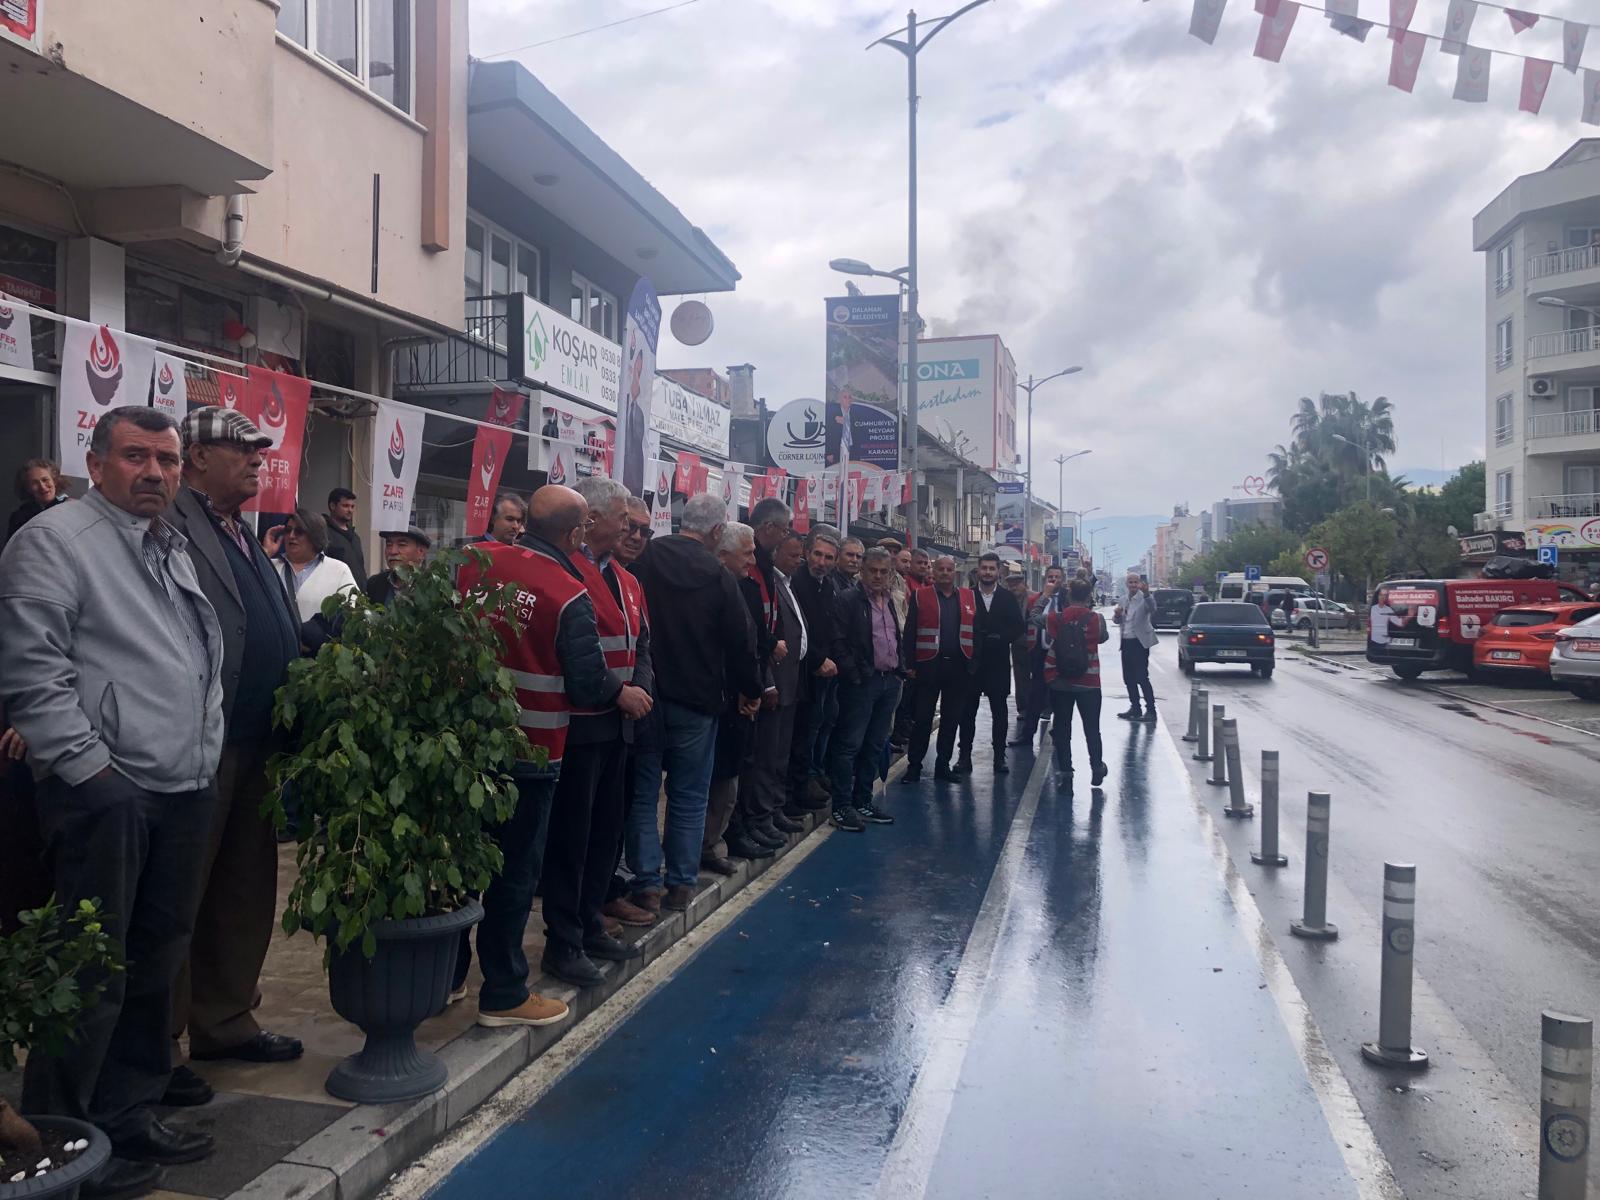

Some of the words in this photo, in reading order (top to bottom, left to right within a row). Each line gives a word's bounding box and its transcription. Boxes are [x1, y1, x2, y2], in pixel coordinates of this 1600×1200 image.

[552, 324, 598, 370] KOŞAR
[561, 364, 590, 394] EMLAK
[662, 380, 688, 413] TUBA
[778, 453, 804, 461] CORNER
[1248, 567, 1258, 580] P
